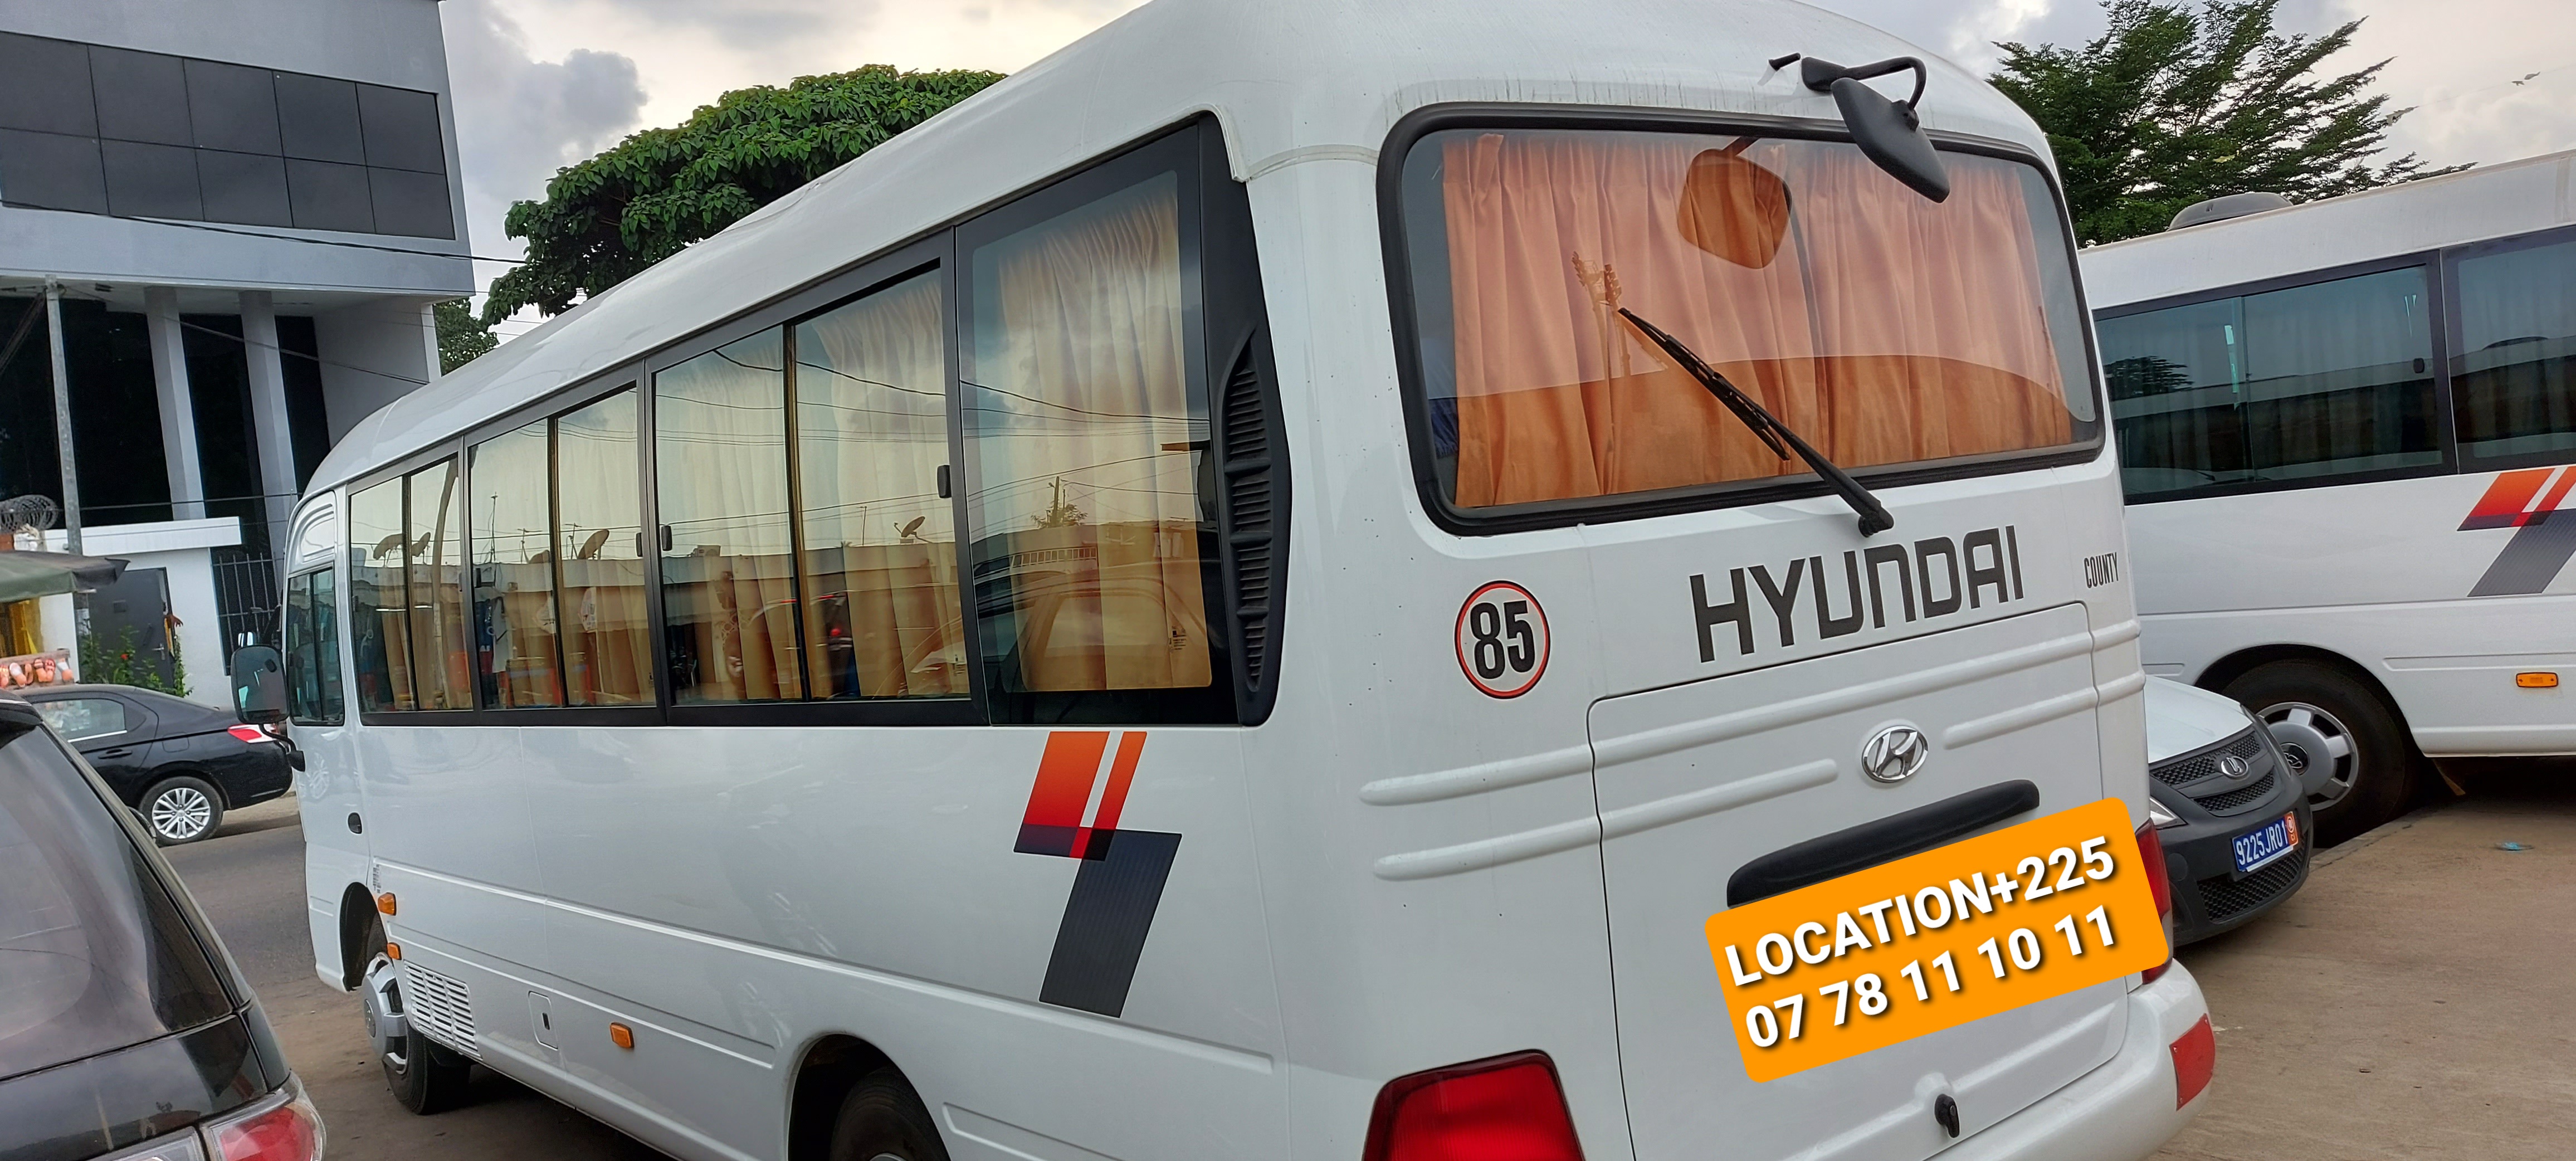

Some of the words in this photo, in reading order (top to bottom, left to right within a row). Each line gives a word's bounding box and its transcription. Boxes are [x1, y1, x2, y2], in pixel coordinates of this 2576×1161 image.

[1690, 525, 2023, 663] HYUNDAI
[2084, 552, 2119, 589] COUNTY
[1470, 600, 1535, 679] 85
